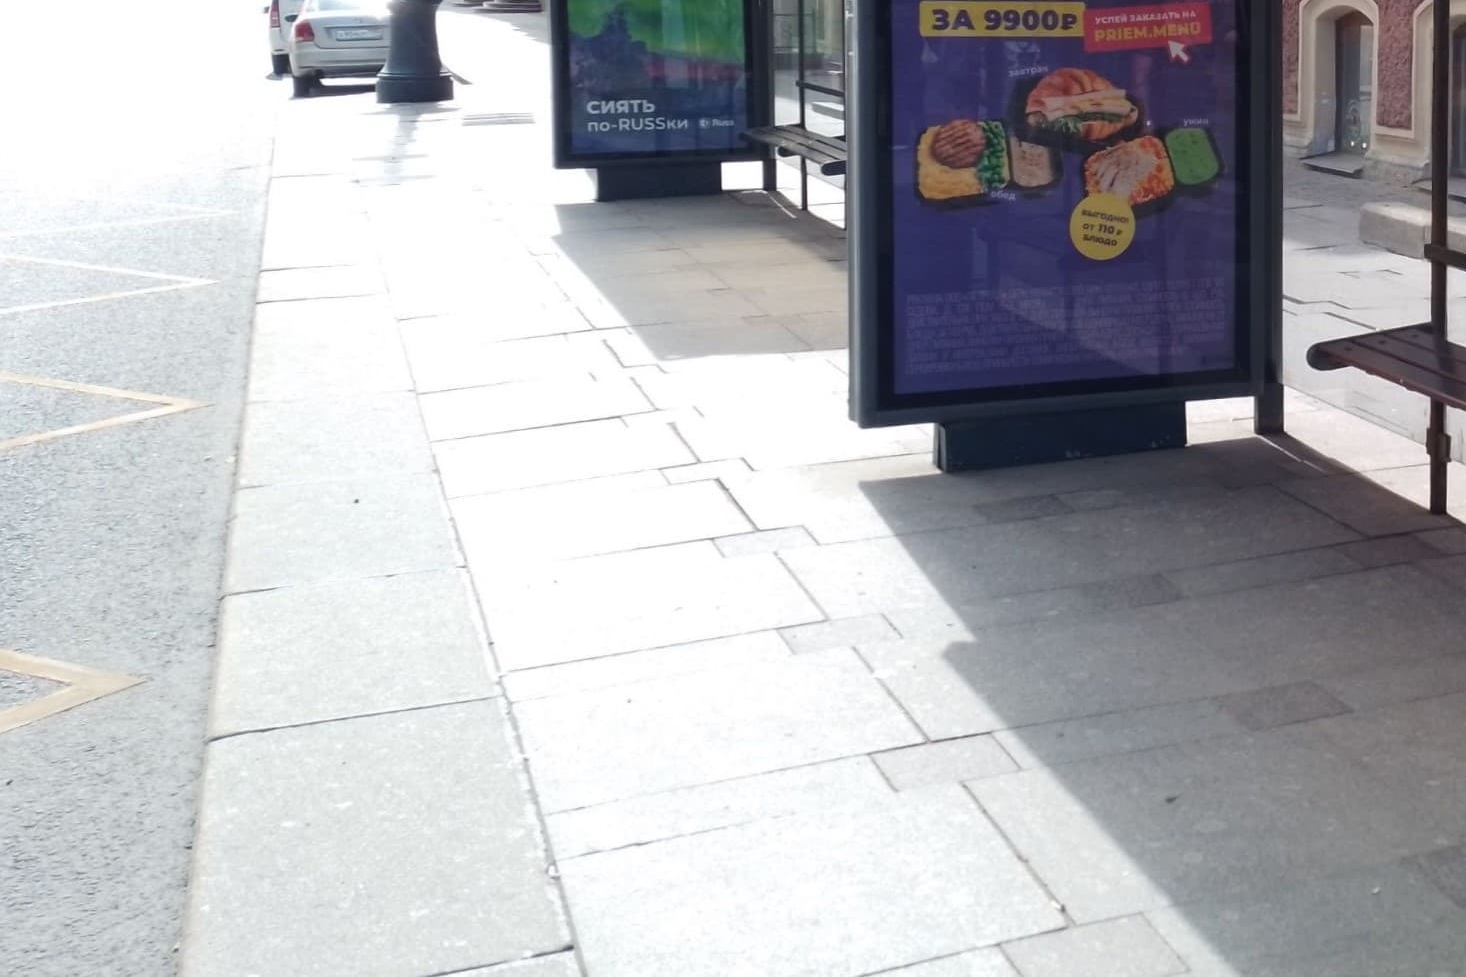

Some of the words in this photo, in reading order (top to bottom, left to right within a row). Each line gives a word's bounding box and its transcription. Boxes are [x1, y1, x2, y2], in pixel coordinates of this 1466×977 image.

[931, 9, 976, 31] ЗА
[1095, 14, 1127, 24] УСПЕЙ
[1129, 12, 1180, 23] ЗАКАЗАТЬ
[1182, 10, 1197, 19] НА
[1094, 22, 1201, 43] PRIEM.MENU
